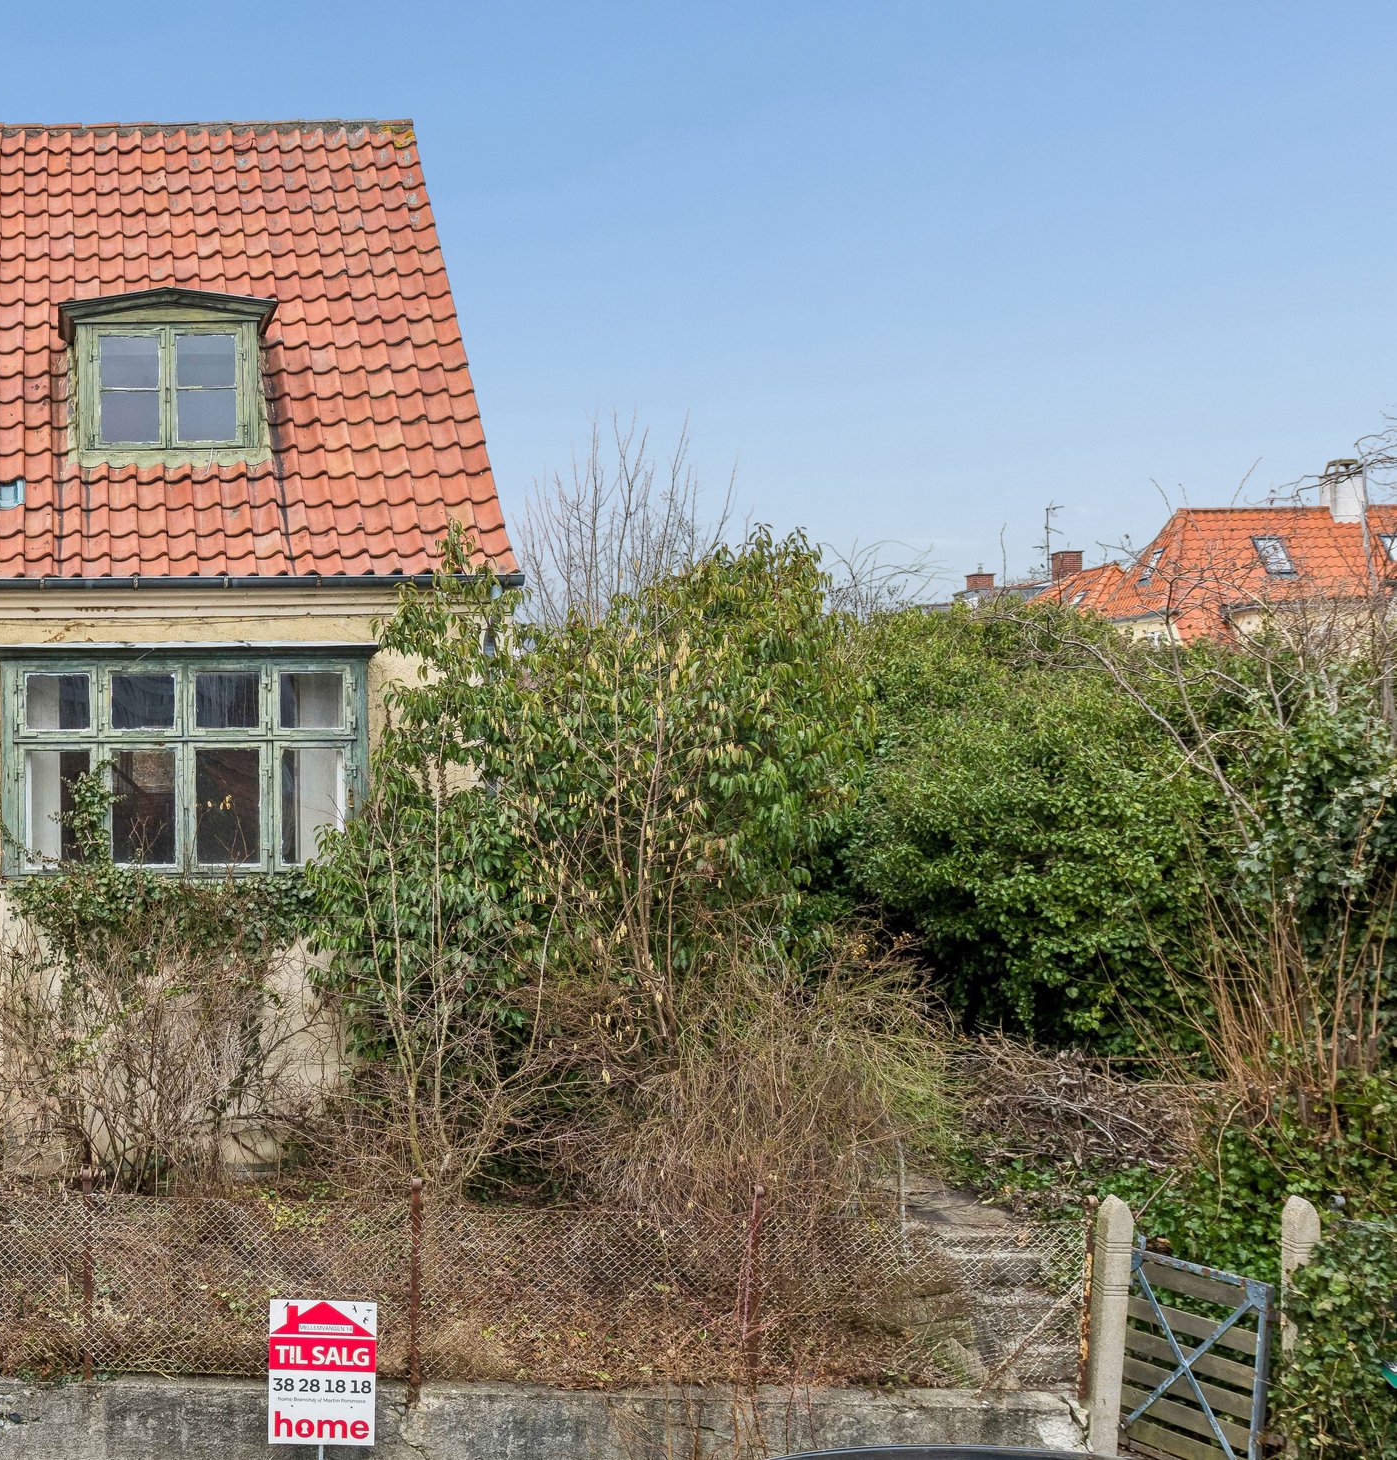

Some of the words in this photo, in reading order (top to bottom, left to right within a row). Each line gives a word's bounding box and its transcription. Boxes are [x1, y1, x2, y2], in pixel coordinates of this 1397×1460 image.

[299, 1324, 345, 1332] MELLEMVANGEN
[275, 1345, 308, 1365] TIL
[312, 1346, 370, 1366] SALG
[273, 1378, 294, 1392] 38
[298, 1378, 320, 1393] 28
[325, 1379, 346, 1393] 18
[350, 1380, 372, 1394] 18
[274, 1411, 370, 1440] home
